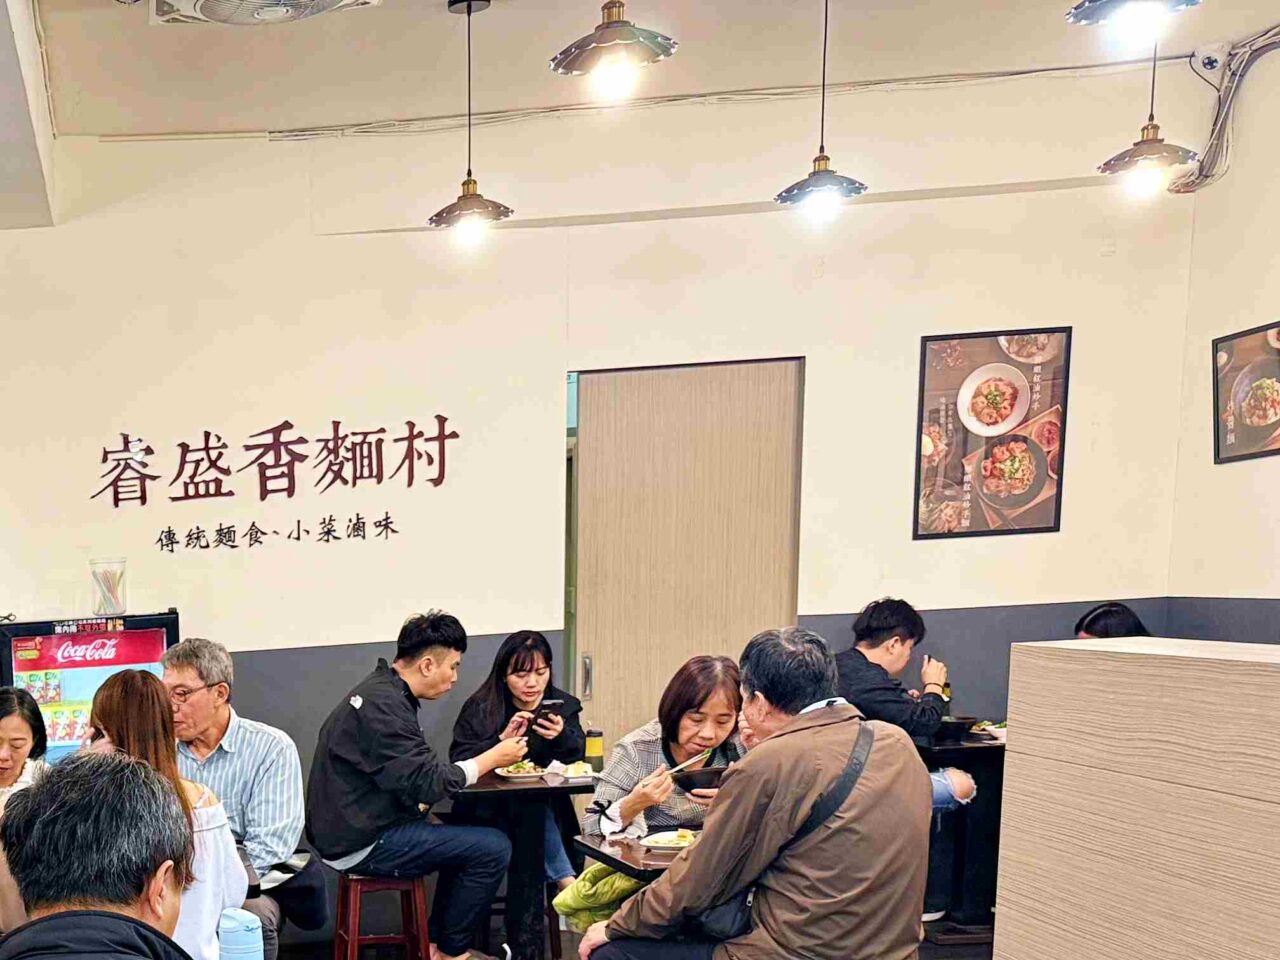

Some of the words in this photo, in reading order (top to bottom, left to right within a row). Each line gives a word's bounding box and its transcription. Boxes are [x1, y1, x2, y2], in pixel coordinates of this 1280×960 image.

[89, 414, 460, 509] 睿盛香麵村
[57, 638, 119, 663] Coca-Cola
